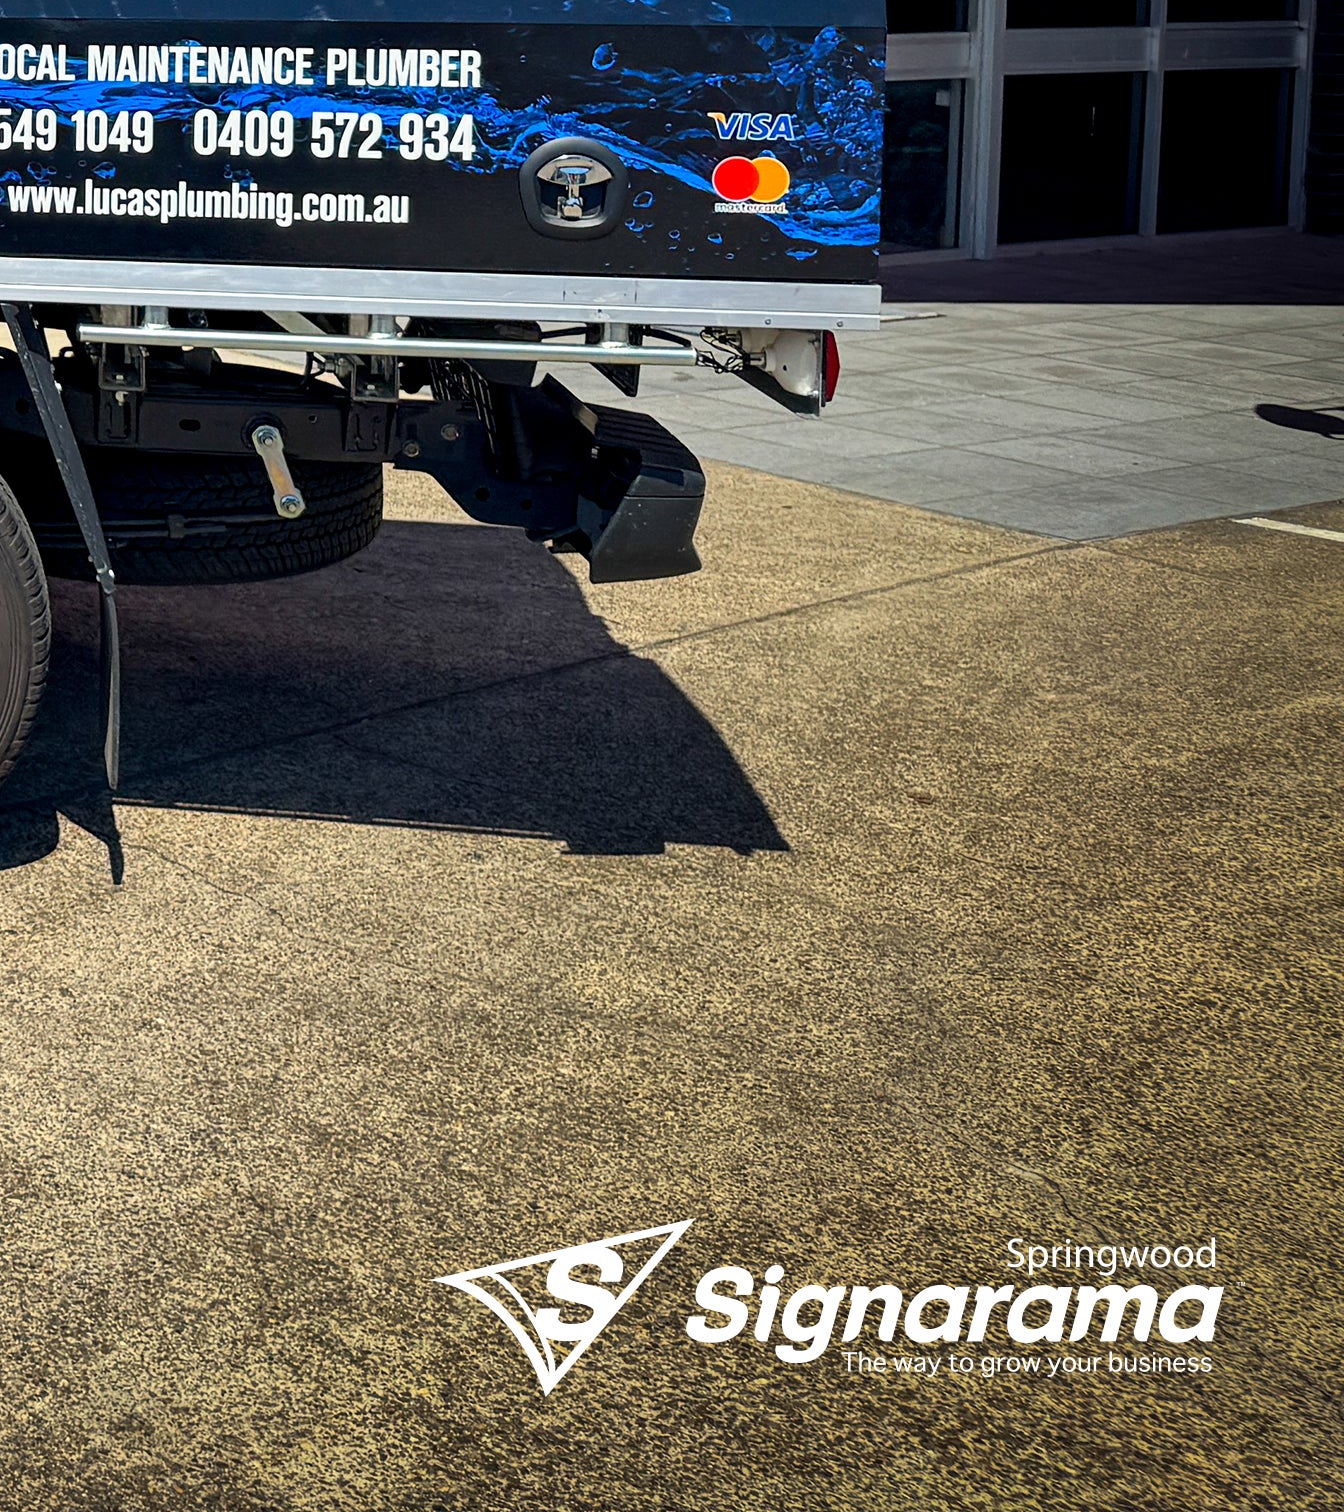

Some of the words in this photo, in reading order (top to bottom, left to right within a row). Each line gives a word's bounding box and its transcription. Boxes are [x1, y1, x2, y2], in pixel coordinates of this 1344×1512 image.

[87, 44, 314, 85] MAINTENANCE
[326, 48, 482, 88] PLUMBER
[71, 109, 154, 153] 1049
[193, 108, 294, 158] 0409
[310, 111, 383, 159] 572
[399, 112, 476, 161] 934
[706, 112, 794, 141] VISA
[8, 178, 410, 228] www.lucasplumbing.com.au
[714, 202, 785, 215] mastercard
